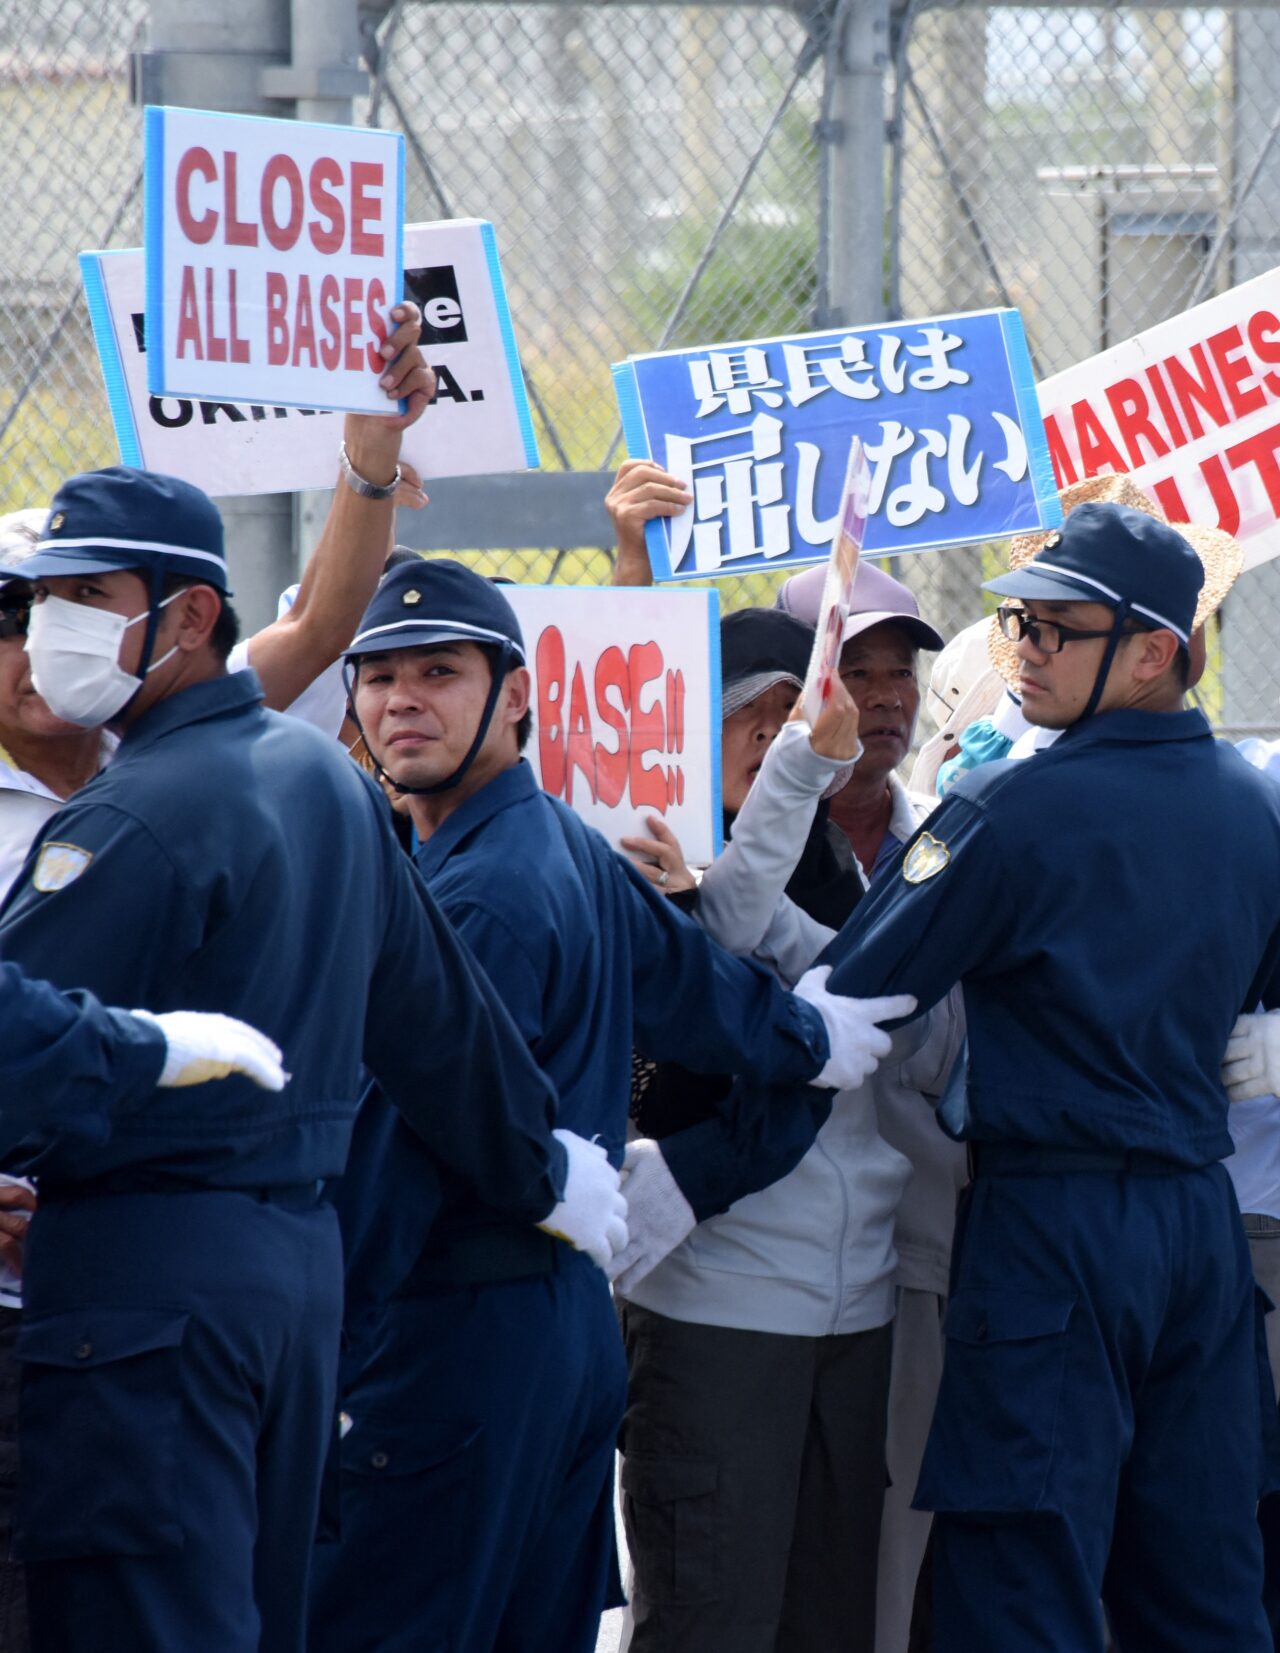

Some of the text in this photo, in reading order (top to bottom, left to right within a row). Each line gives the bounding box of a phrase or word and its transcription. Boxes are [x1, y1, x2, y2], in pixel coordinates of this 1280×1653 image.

[176, 145, 385, 257] CLOSE
[177, 265, 251, 364] ALL
[267, 271, 386, 374] BASES
[688, 328, 970, 418] 県民は
[664, 411, 1030, 574] 屈しない
[535, 624, 685, 816] BASE!!
